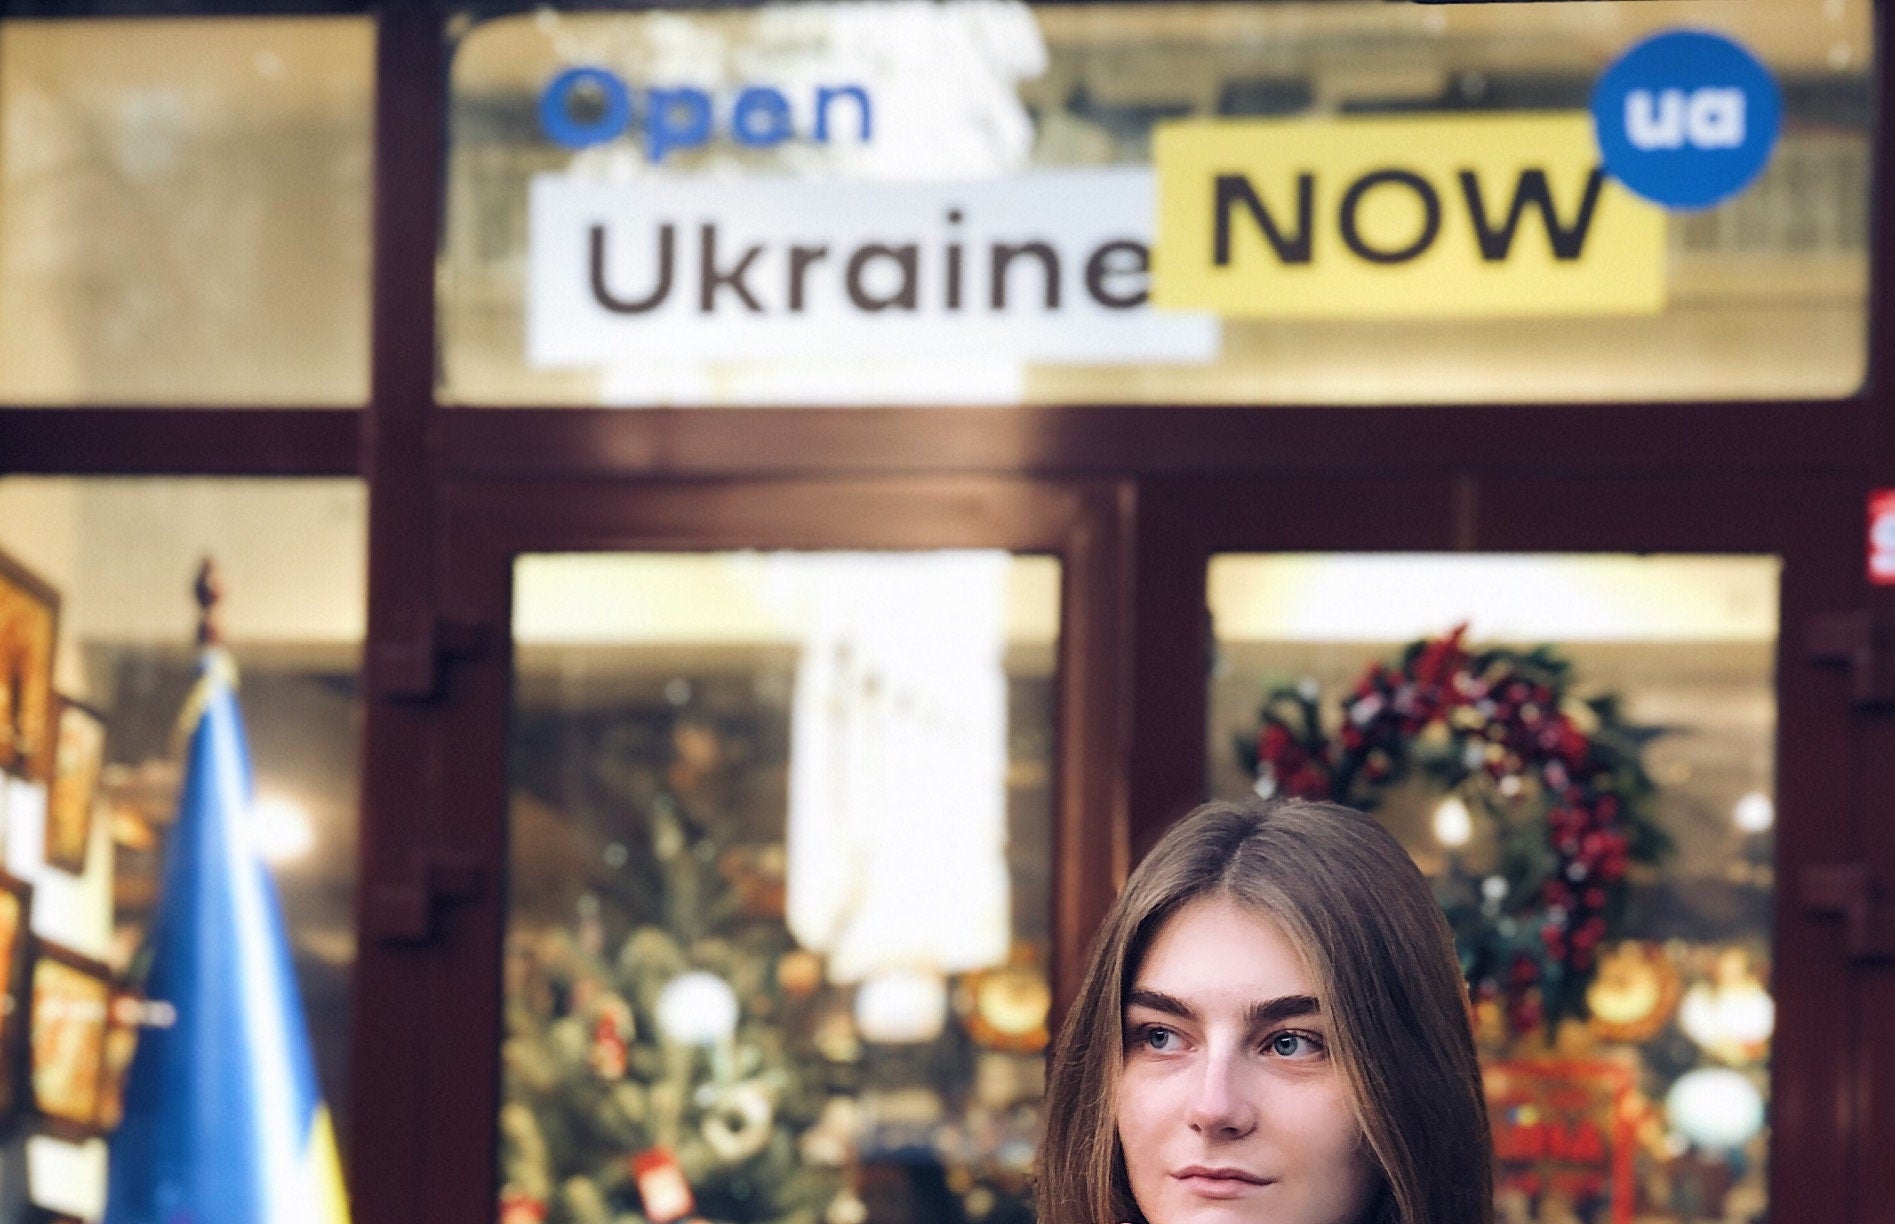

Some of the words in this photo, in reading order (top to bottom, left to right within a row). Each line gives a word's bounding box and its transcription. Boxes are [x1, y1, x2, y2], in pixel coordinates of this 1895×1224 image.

[538, 67, 874, 163] Open
[1625, 88, 1747, 149] ua
[586, 209, 1152, 314] Ukraine
[1212, 167, 1606, 267] NOW
